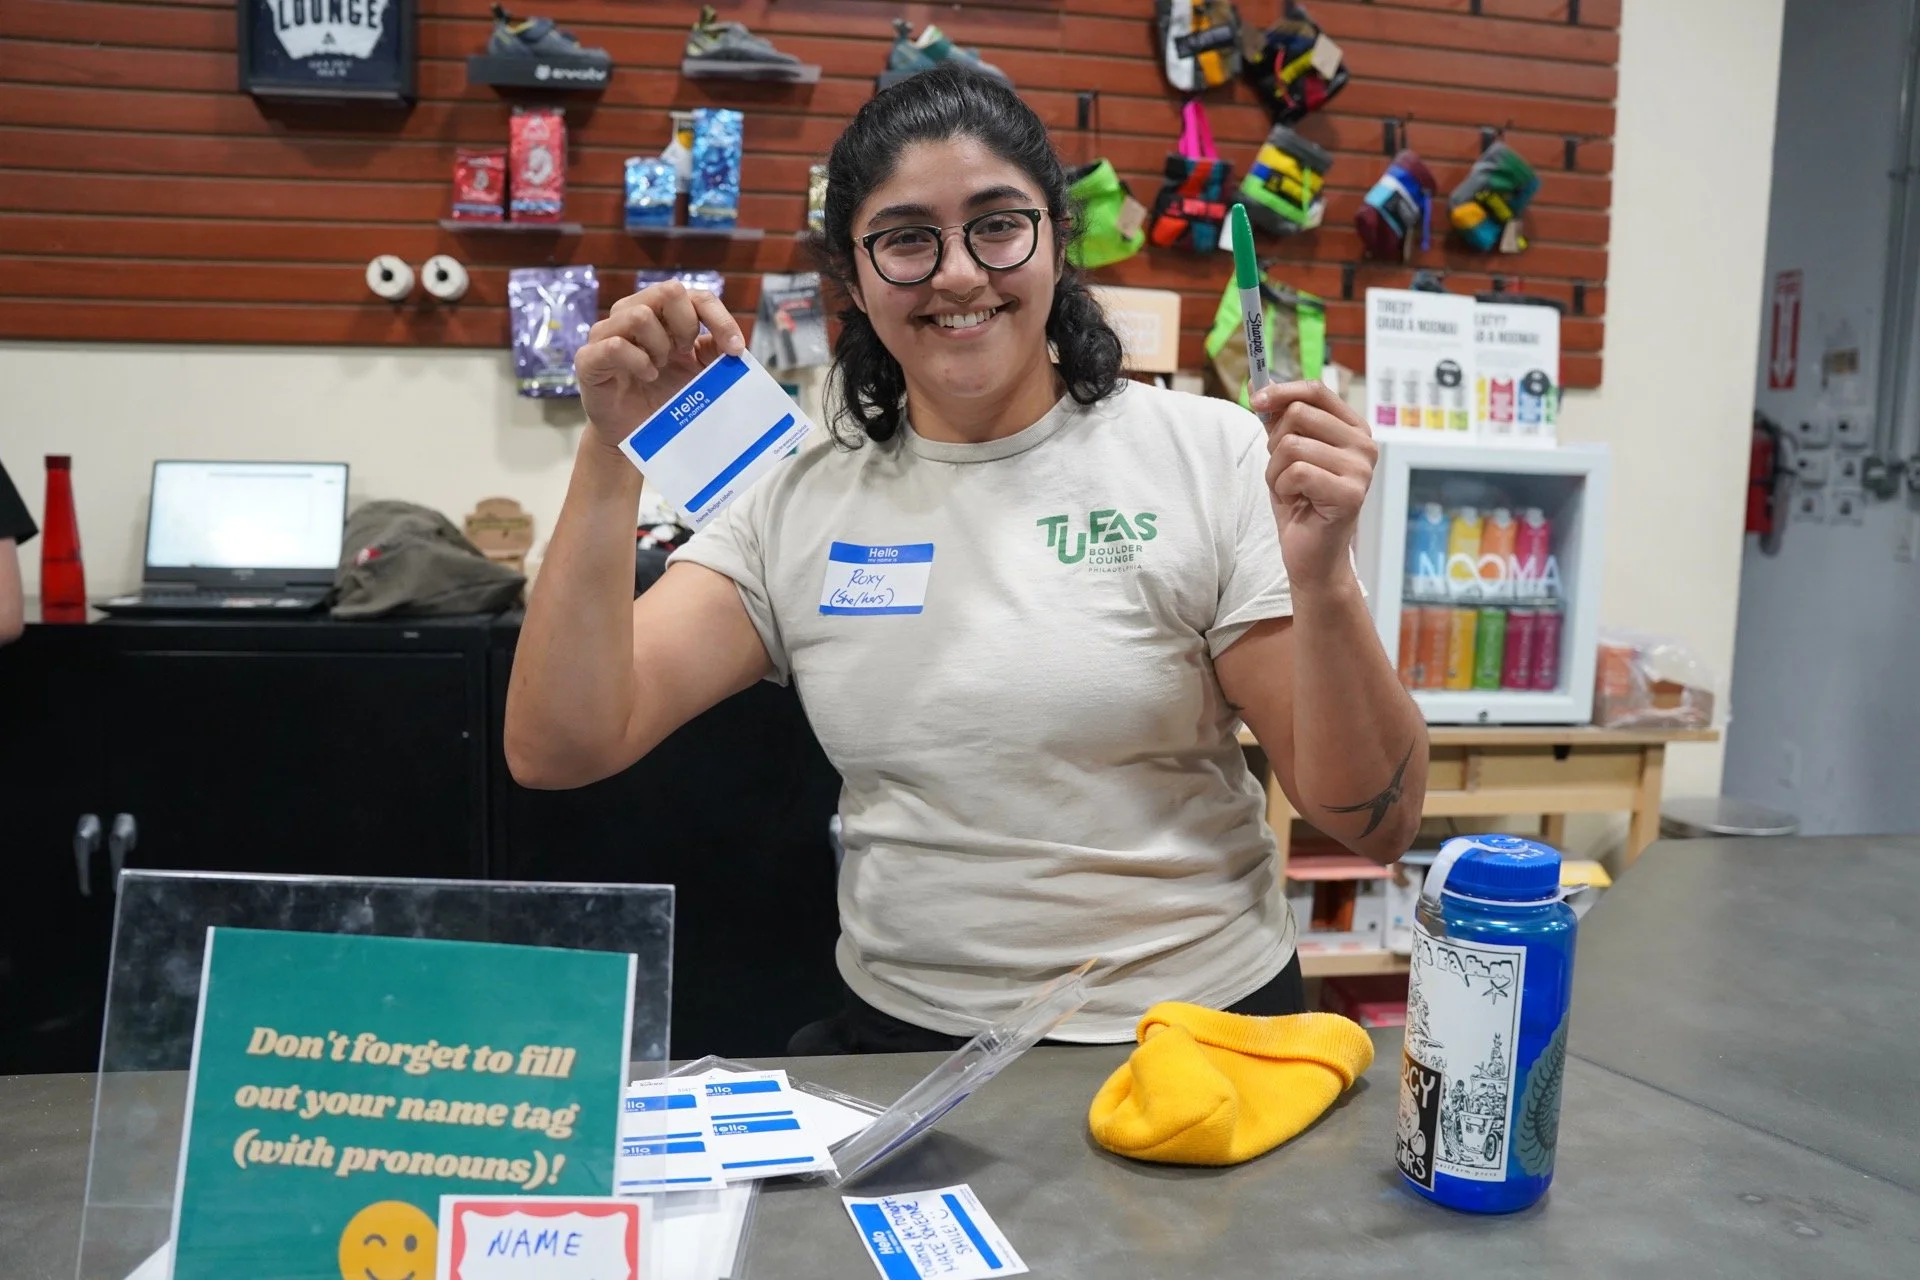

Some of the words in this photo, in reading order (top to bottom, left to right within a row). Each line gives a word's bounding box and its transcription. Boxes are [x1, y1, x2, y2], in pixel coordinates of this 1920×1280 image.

[279, 0, 378, 30] LOUNGE
[670, 390, 705, 421] Hello
[678, 417, 690, 427] my
[688, 402, 705, 418] name
[1036, 509, 1158, 565] TUFAS
[1088, 544, 1143, 556] BOULDER
[868, 547, 899, 559] Hello
[1088, 553, 1135, 565] LOUNGE
[1088, 565, 1143, 573] PHILADELPHIA
[1418, 551, 1564, 595] NOOMA
[246, 1026, 350, 1061] Don't
[349, 1032, 470, 1075] forget
[471, 1045, 513, 1074] to
[514, 1043, 576, 1078] fill
[705, 1086, 732, 1094] ello
[234, 1083, 302, 1111] out
[298, 1089, 397, 1120] your
[396, 1095, 509, 1127] name
[510, 1101, 581, 1140] tag
[233, 1127, 336, 1170] (with
[334, 1144, 566, 1191] pronouns)!
[487, 1228, 583, 1258] NAME
[872, 1231, 895, 1255] Hello
